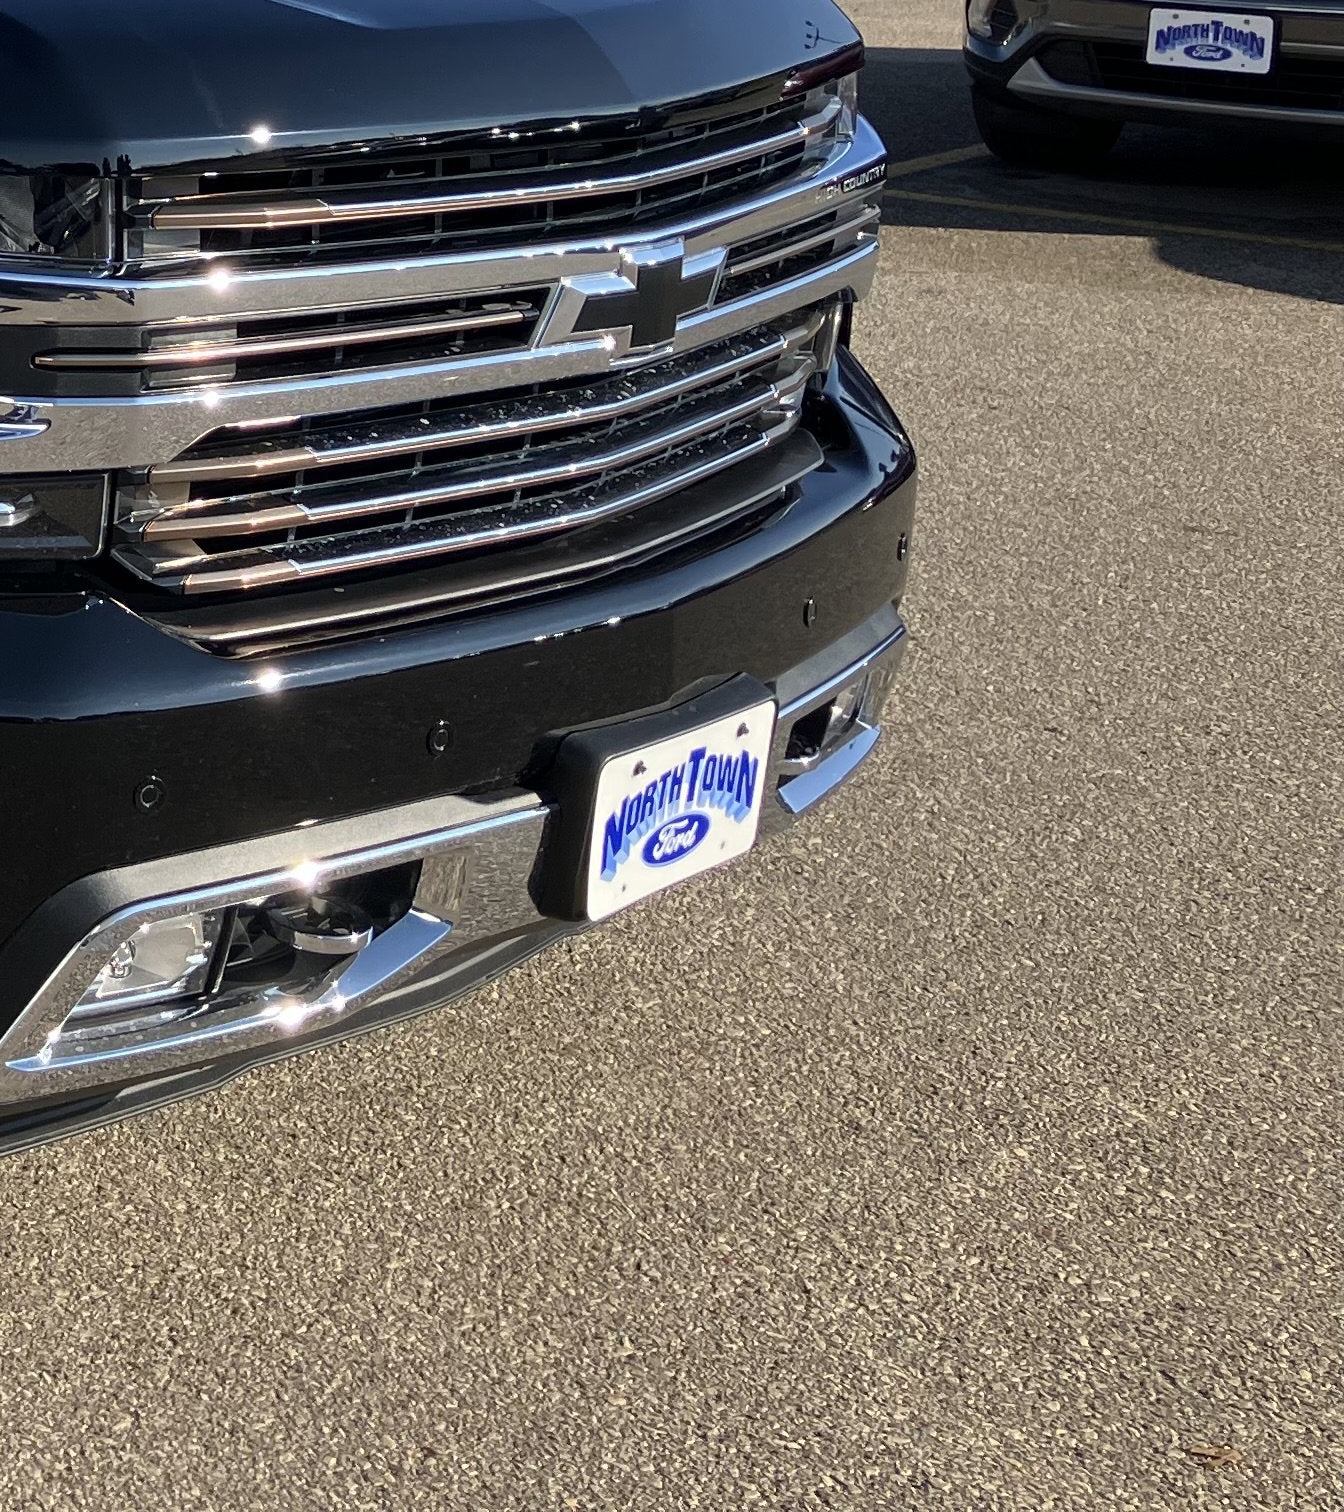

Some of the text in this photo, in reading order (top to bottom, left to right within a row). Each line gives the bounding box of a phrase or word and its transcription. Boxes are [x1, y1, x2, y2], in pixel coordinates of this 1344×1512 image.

[1191, 45, 1224, 59] Ford
[843, 163, 886, 193] COUNTRY
[652, 818, 699, 861] Ford
